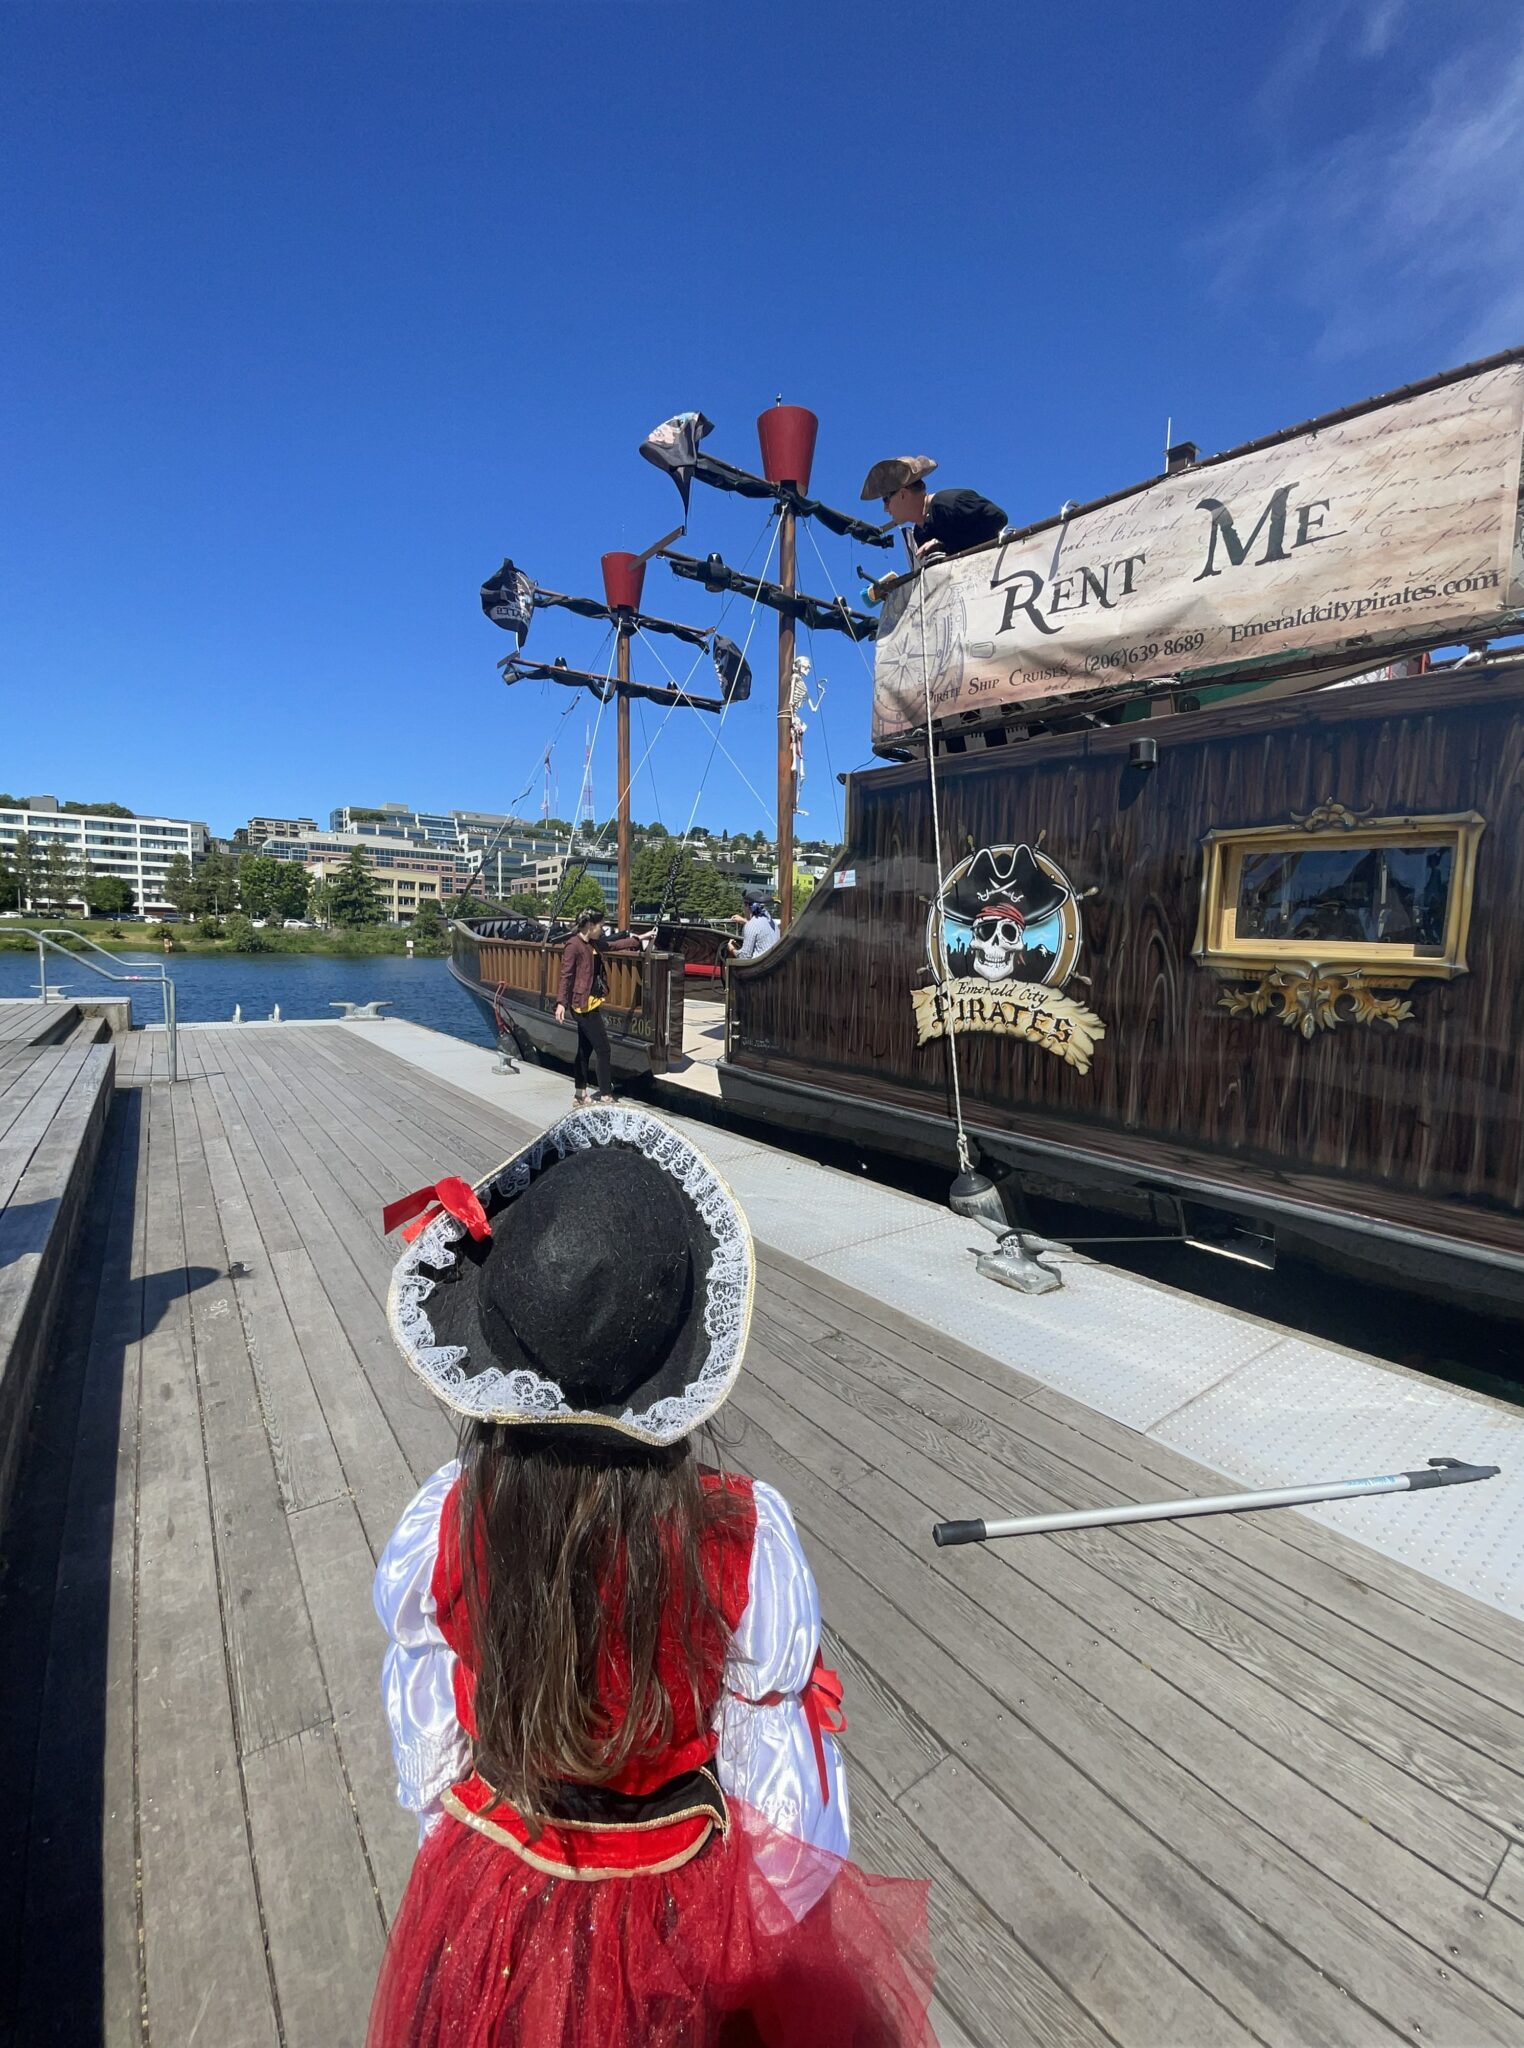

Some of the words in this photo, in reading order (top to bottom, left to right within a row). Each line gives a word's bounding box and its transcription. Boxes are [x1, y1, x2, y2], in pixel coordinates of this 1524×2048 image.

[991, 554, 1146, 635] RENT
[1193, 482, 1347, 582] ME
[1230, 573, 1500, 643] Emeraldcitypirates.com
[968, 677, 1000, 695] SHIP
[1009, 667, 1067, 687] CRUISES
[931, 990, 1077, 1043] PIRATES
[956, 982, 1017, 998] Emerald
[1019, 987, 1050, 1009] City
